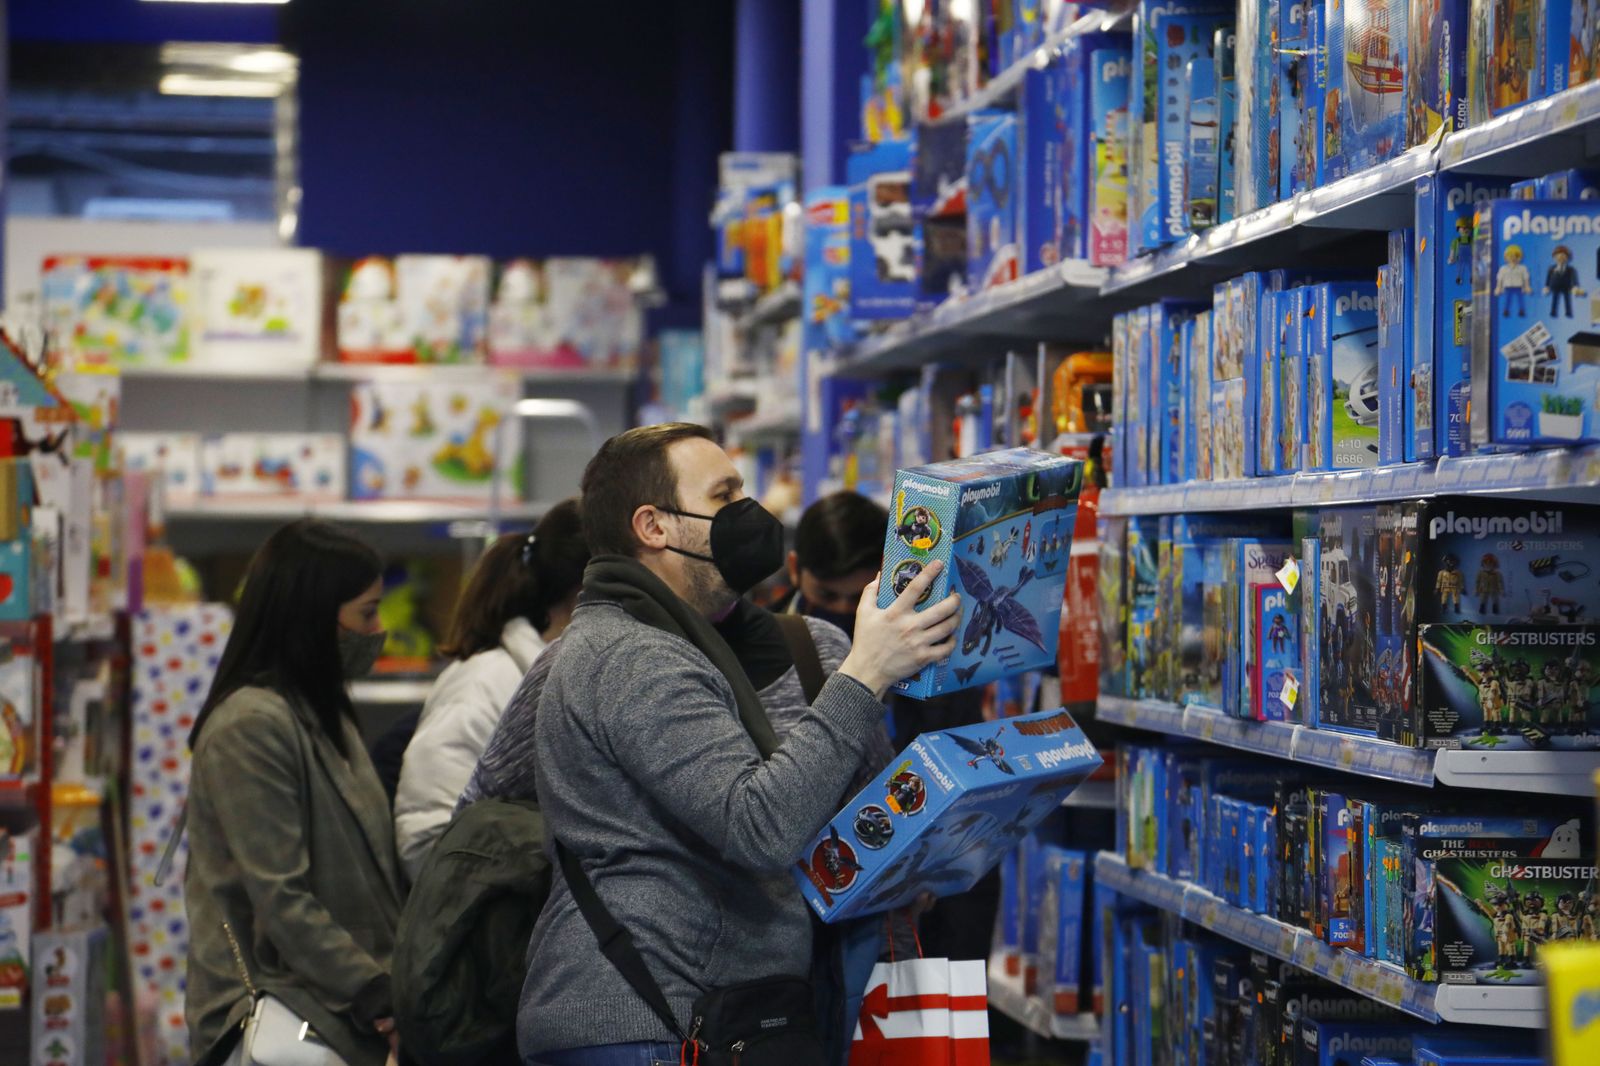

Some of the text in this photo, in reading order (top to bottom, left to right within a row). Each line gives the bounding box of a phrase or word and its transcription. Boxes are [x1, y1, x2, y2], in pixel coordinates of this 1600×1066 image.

[1457, 97, 1468, 128] 70075
[1166, 141, 1186, 237] playmobil
[1335, 454, 1364, 464] 6686
[902, 478, 951, 498] playmobil
[960, 482, 1001, 507] playmobil
[1429, 510, 1563, 540] playmobil
[1476, 631, 1597, 646] GHOSTBUSTERS
[911, 740, 956, 792] playmobil
[1035, 739, 1097, 769] playmobil
[1419, 822, 1483, 836] playmobil
[1441, 839, 1465, 849] THE
